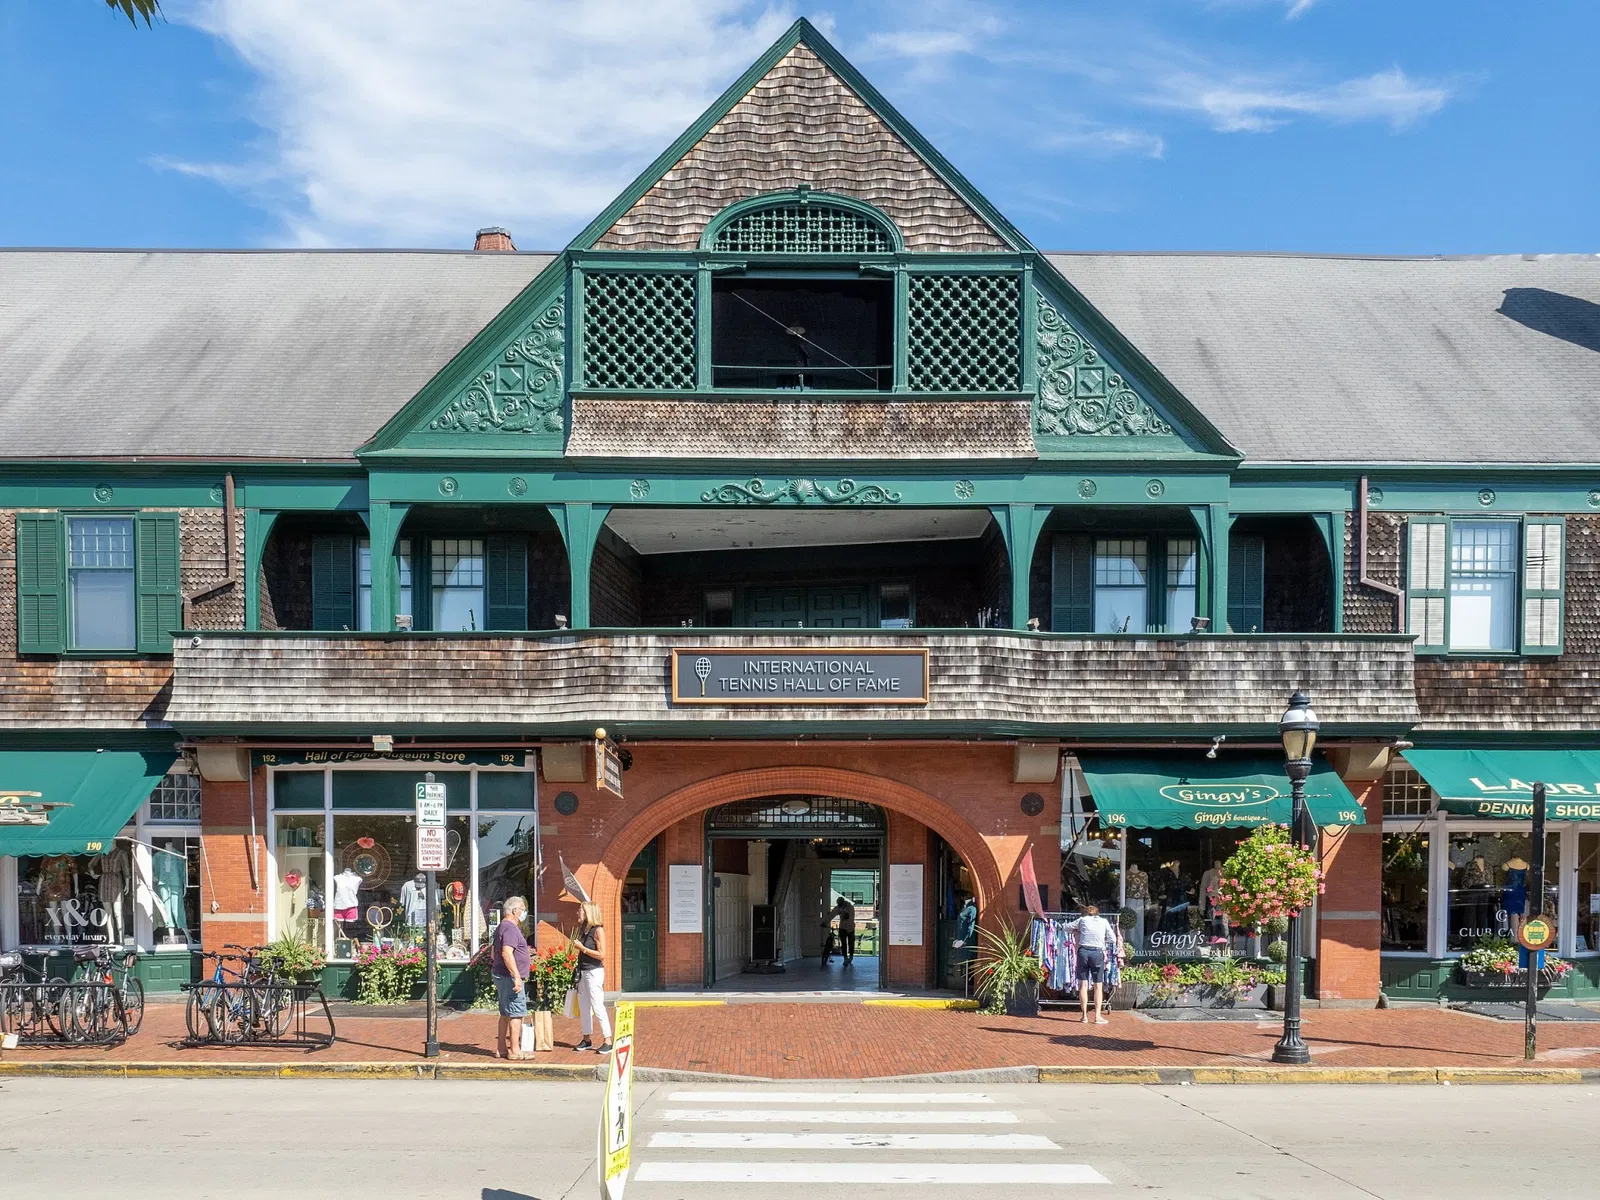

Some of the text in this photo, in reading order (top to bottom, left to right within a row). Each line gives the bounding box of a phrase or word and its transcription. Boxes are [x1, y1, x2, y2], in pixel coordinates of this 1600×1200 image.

[743, 660, 874, 674] INTERNATIONAL
[719, 678, 900, 690] TENNIS HALL OF FAME
[262, 754, 276, 763] 192
[305, 751, 466, 761] Hall of Fame Museum Store
[500, 754, 514, 762] 192
[418, 786, 424, 798] 2
[1469, 778, 1600, 795] LAUR
[1178, 788, 1261, 802] Gingy's
[1478, 802, 1534, 814] DENIM
[1108, 814, 1126, 824] 196
[1194, 812, 1232, 824] Gingy's
[1338, 811, 1356, 821] 196
[86, 842, 102, 850] 190
[45, 898, 108, 926] x&o
[44, 932, 108, 942] everyday luxury
[1460, 928, 1515, 937] CLUB CA
[1150, 931, 1205, 950] Gingy's
[619, 1008, 632, 1022] STATE
